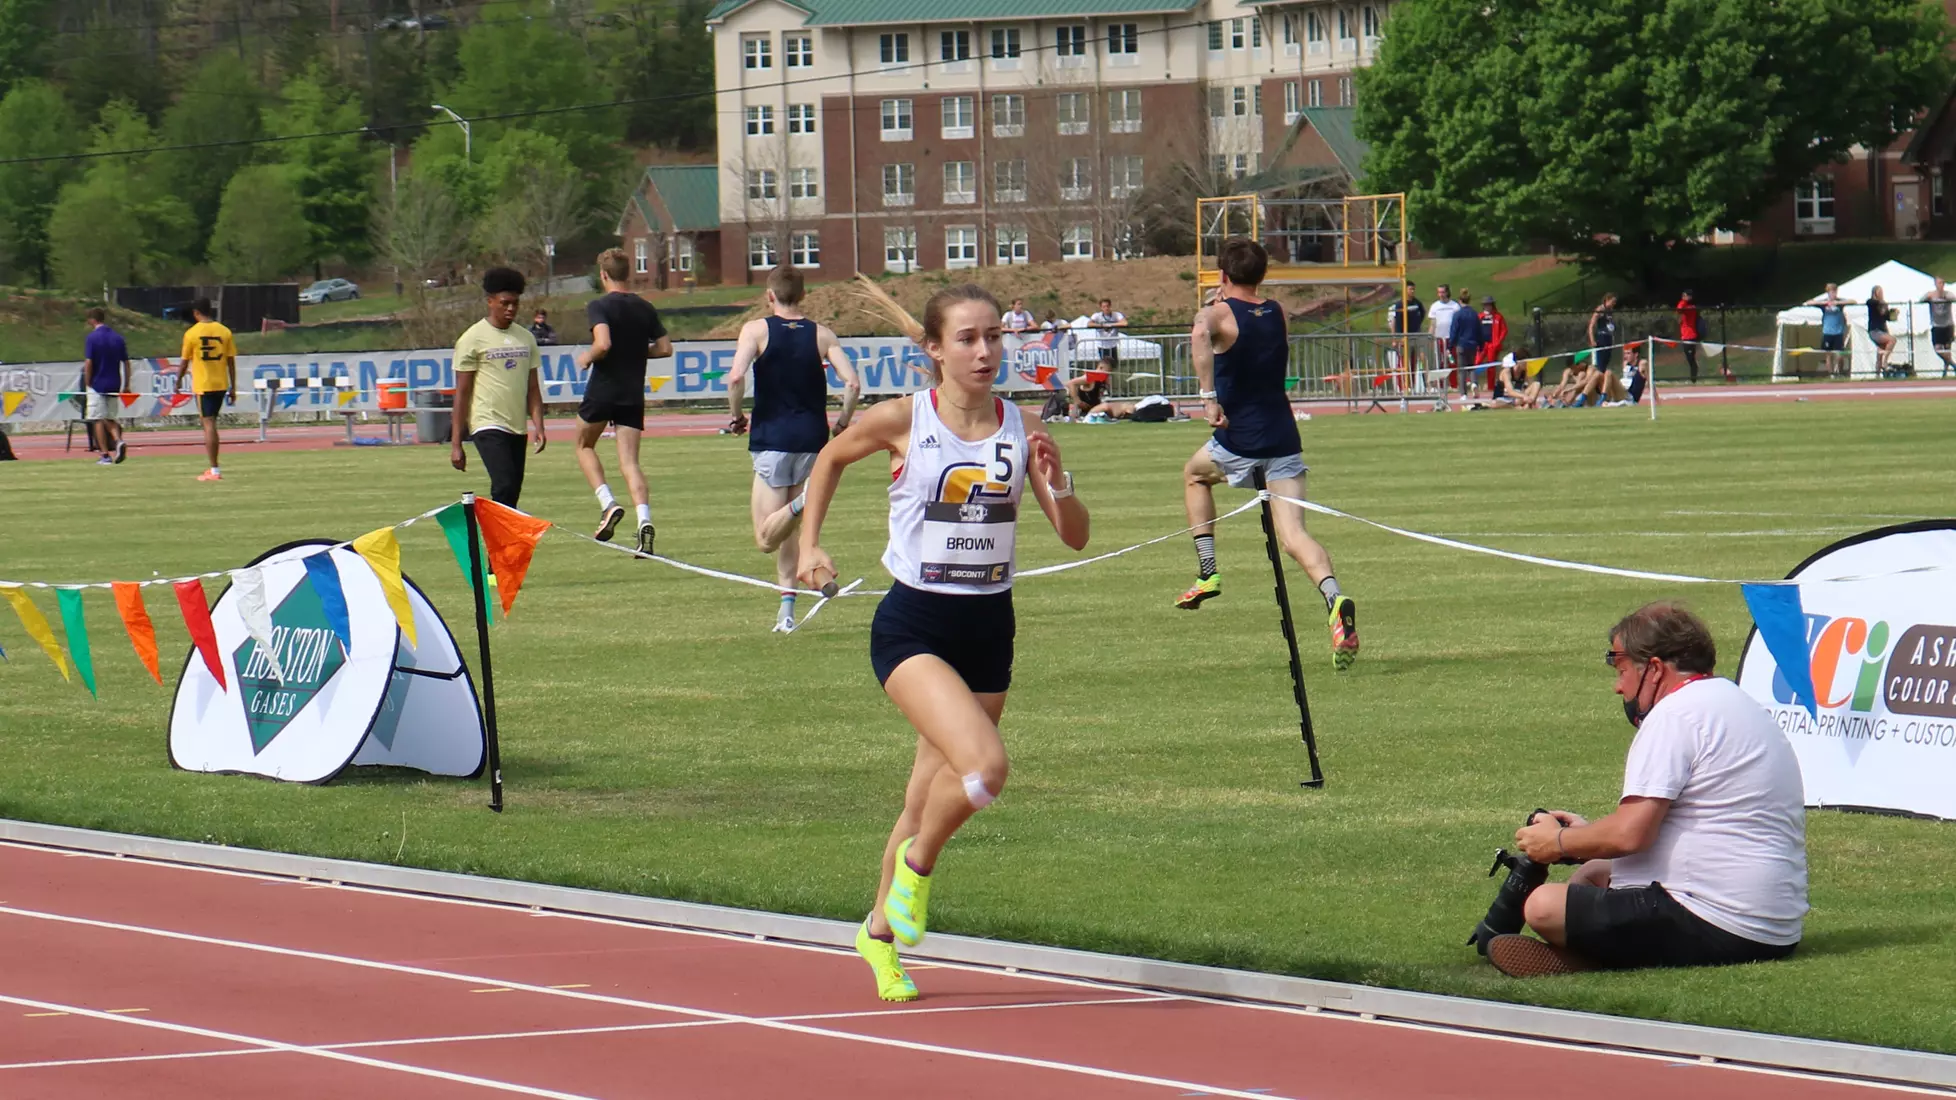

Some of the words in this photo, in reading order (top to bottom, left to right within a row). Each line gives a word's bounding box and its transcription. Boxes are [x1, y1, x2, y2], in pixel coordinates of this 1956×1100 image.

[199, 336, 223, 361] E
[995, 442, 1013, 482] 5
[946, 537, 995, 551] BROWN
[947, 570, 986, 579] #SOCONTF
[241, 625, 335, 683] HOLSTON
[1910, 635, 1956, 668] ASH
[250, 690, 297, 717] GASES
[1888, 676, 1950, 705] COLOR
[1766, 708, 1813, 735] GITAL
[1817, 713, 1888, 741] PRINTING
[1903, 721, 1956, 748] CUSTO
